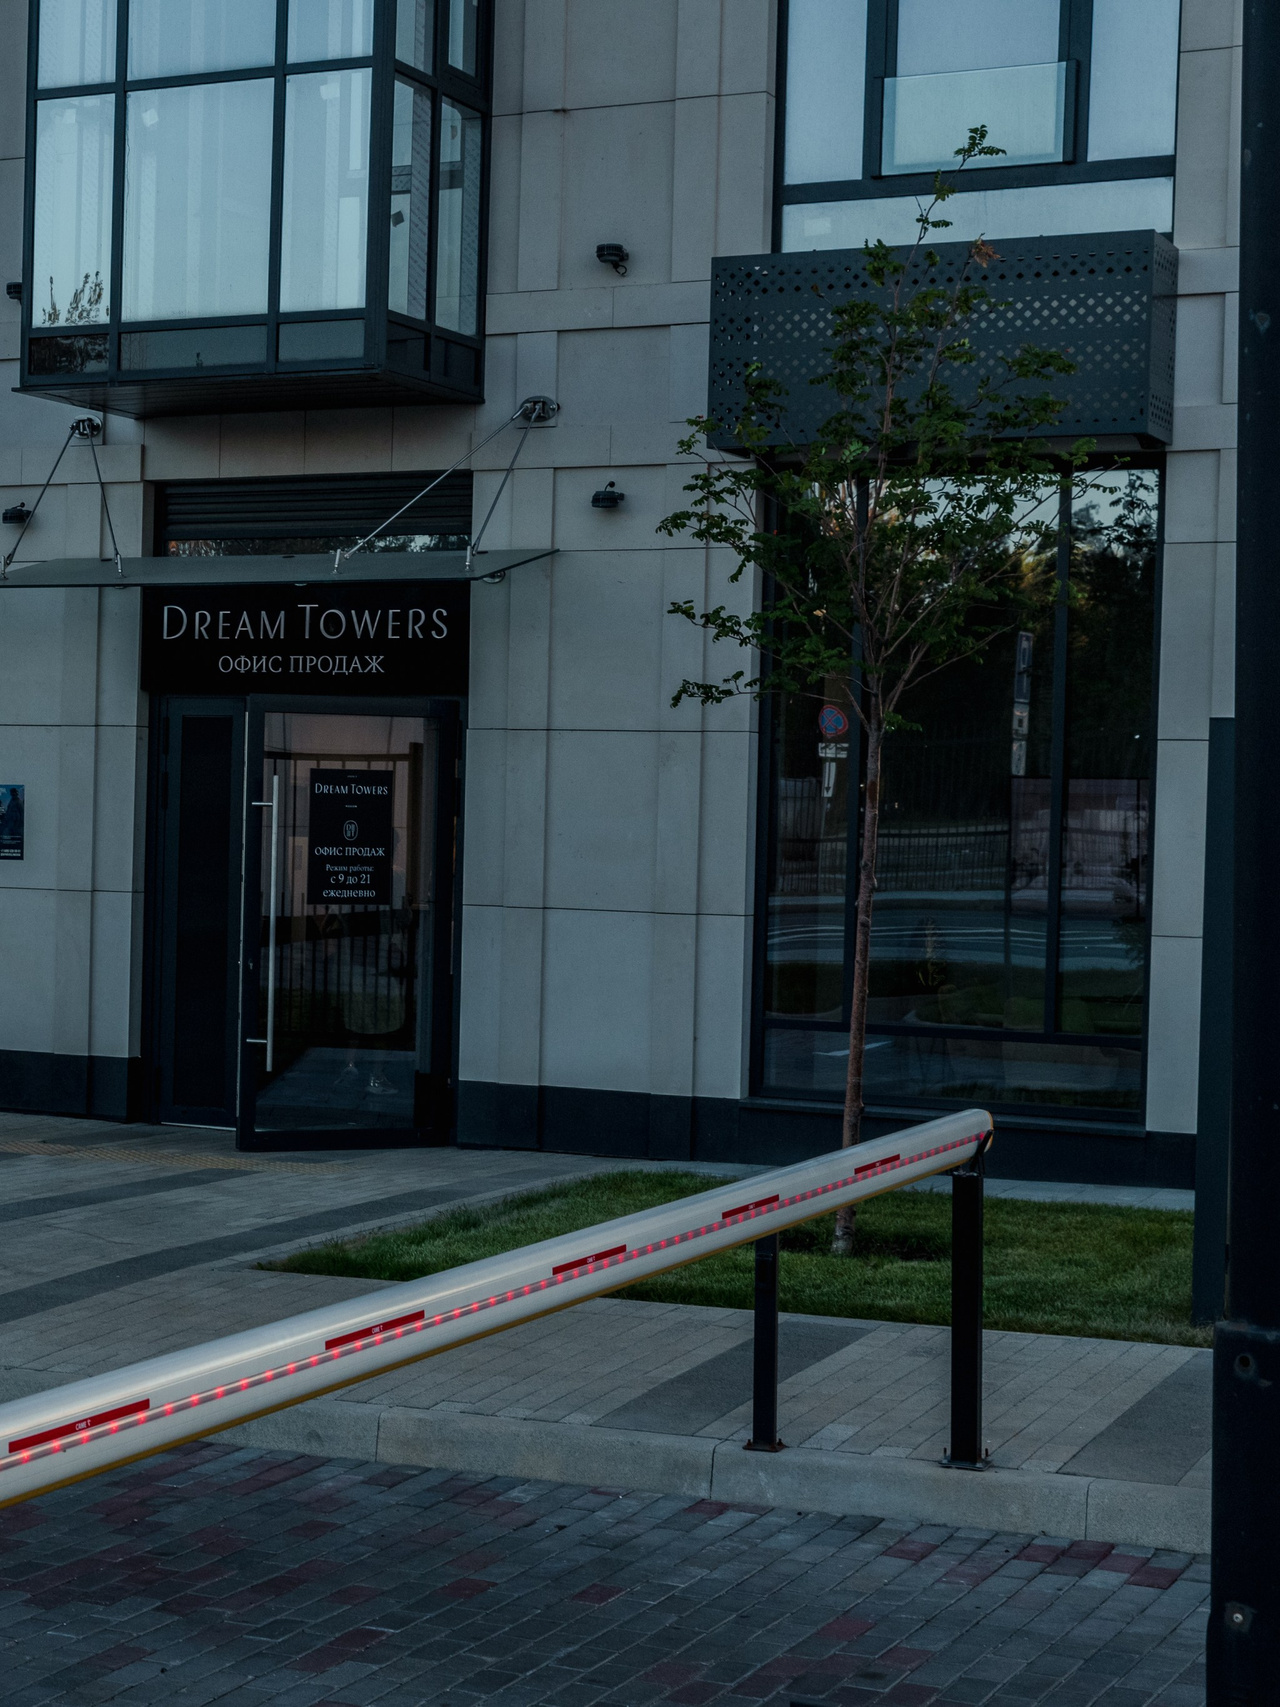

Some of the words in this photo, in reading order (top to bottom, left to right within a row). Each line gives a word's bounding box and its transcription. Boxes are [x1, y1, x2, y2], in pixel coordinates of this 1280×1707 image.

[162, 604, 286, 640] DREAM
[297, 603, 449, 640] TOWERS
[218, 655, 282, 674] ОФИС
[289, 655, 386, 676] ПРОДАЖ
[314, 782, 348, 795] DREAM
[350, 783, 389, 796] TOWERS
[314, 846, 343, 857] ОФИС
[345, 847, 385, 858] ПРОДАЖ
[325, 863, 348, 872] Режим
[338, 874, 345, 884] 9
[346, 876, 358, 885] до
[360, 874, 371, 884] 21
[322, 888, 376, 899] ежедневно
